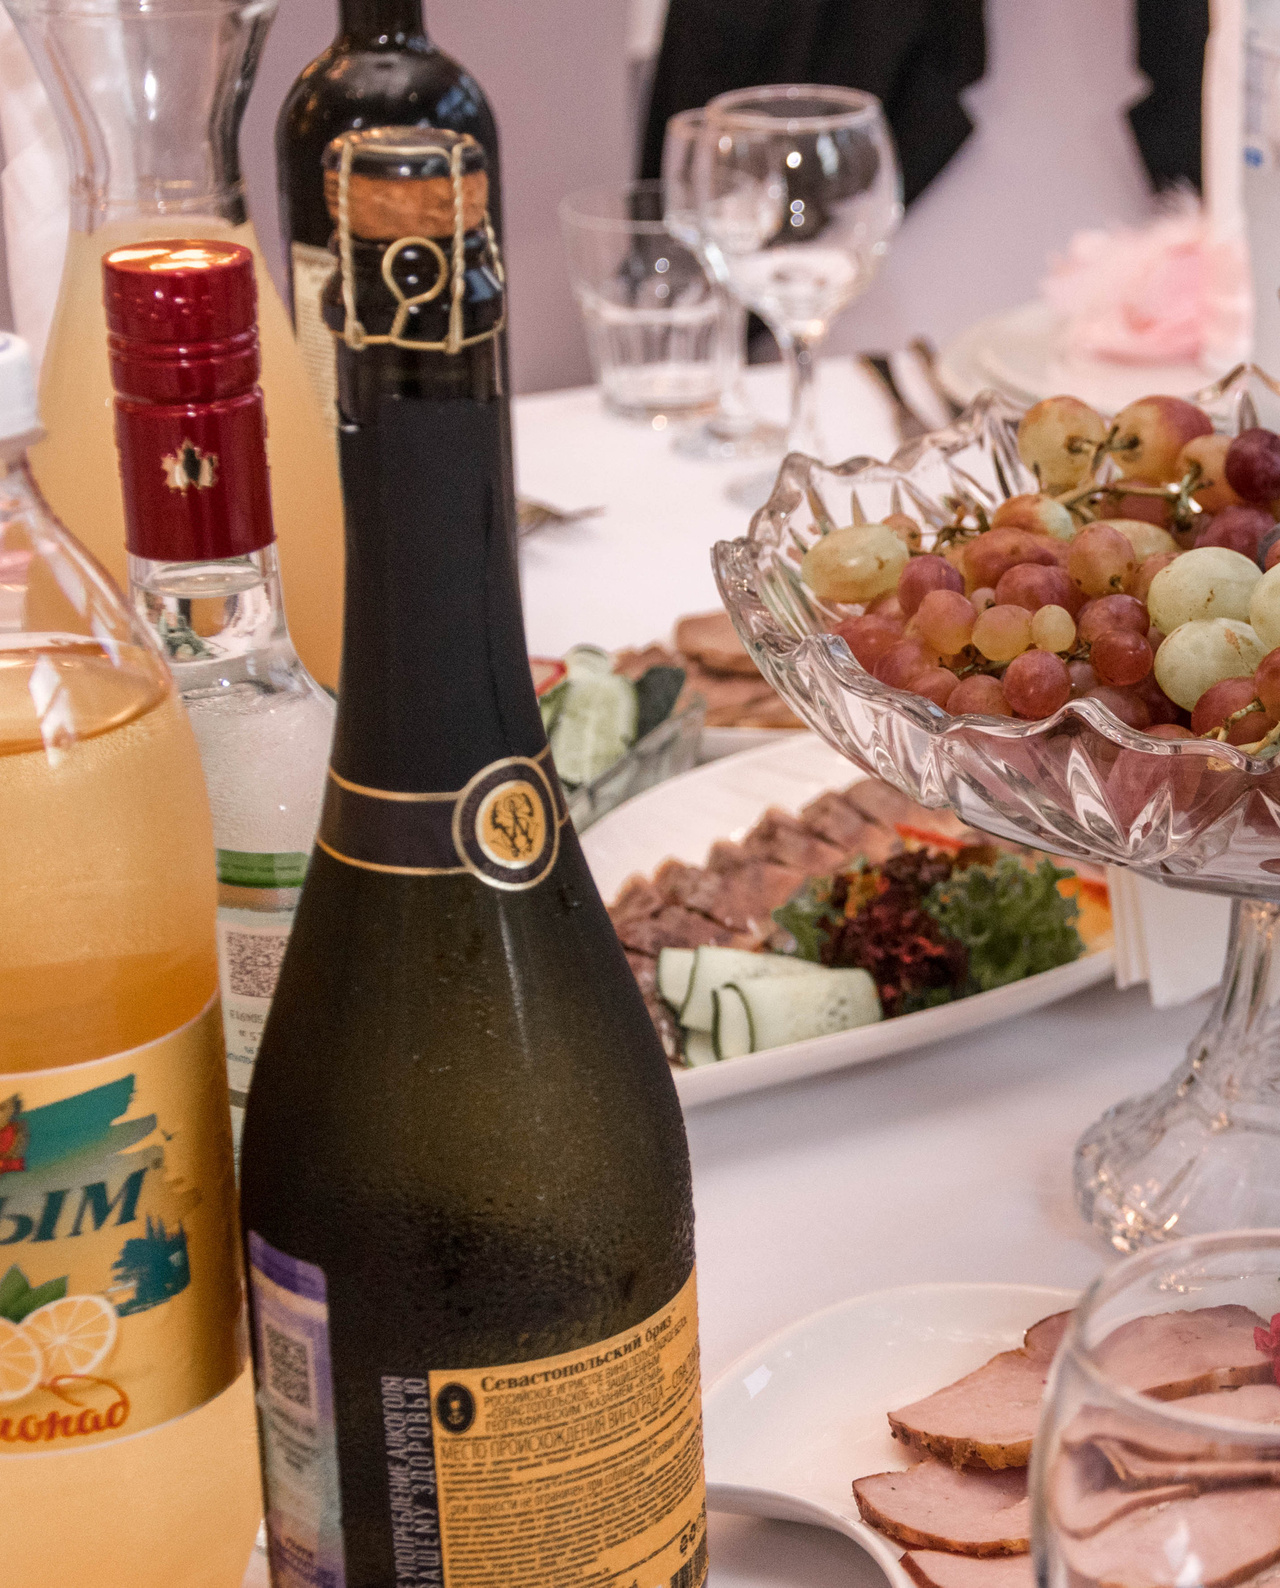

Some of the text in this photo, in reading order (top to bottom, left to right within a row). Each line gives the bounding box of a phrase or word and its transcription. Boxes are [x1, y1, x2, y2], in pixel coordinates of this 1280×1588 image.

[481, 1333, 642, 1392] Севастопольский
[644, 1312, 671, 1346] бриз
[404, 1377, 437, 1495] ЗДОРОВЬЮ
[441, 1442, 486, 1459] МЕСТО
[388, 1461, 416, 1579] УПОТРЕБЛЕНИЕ
